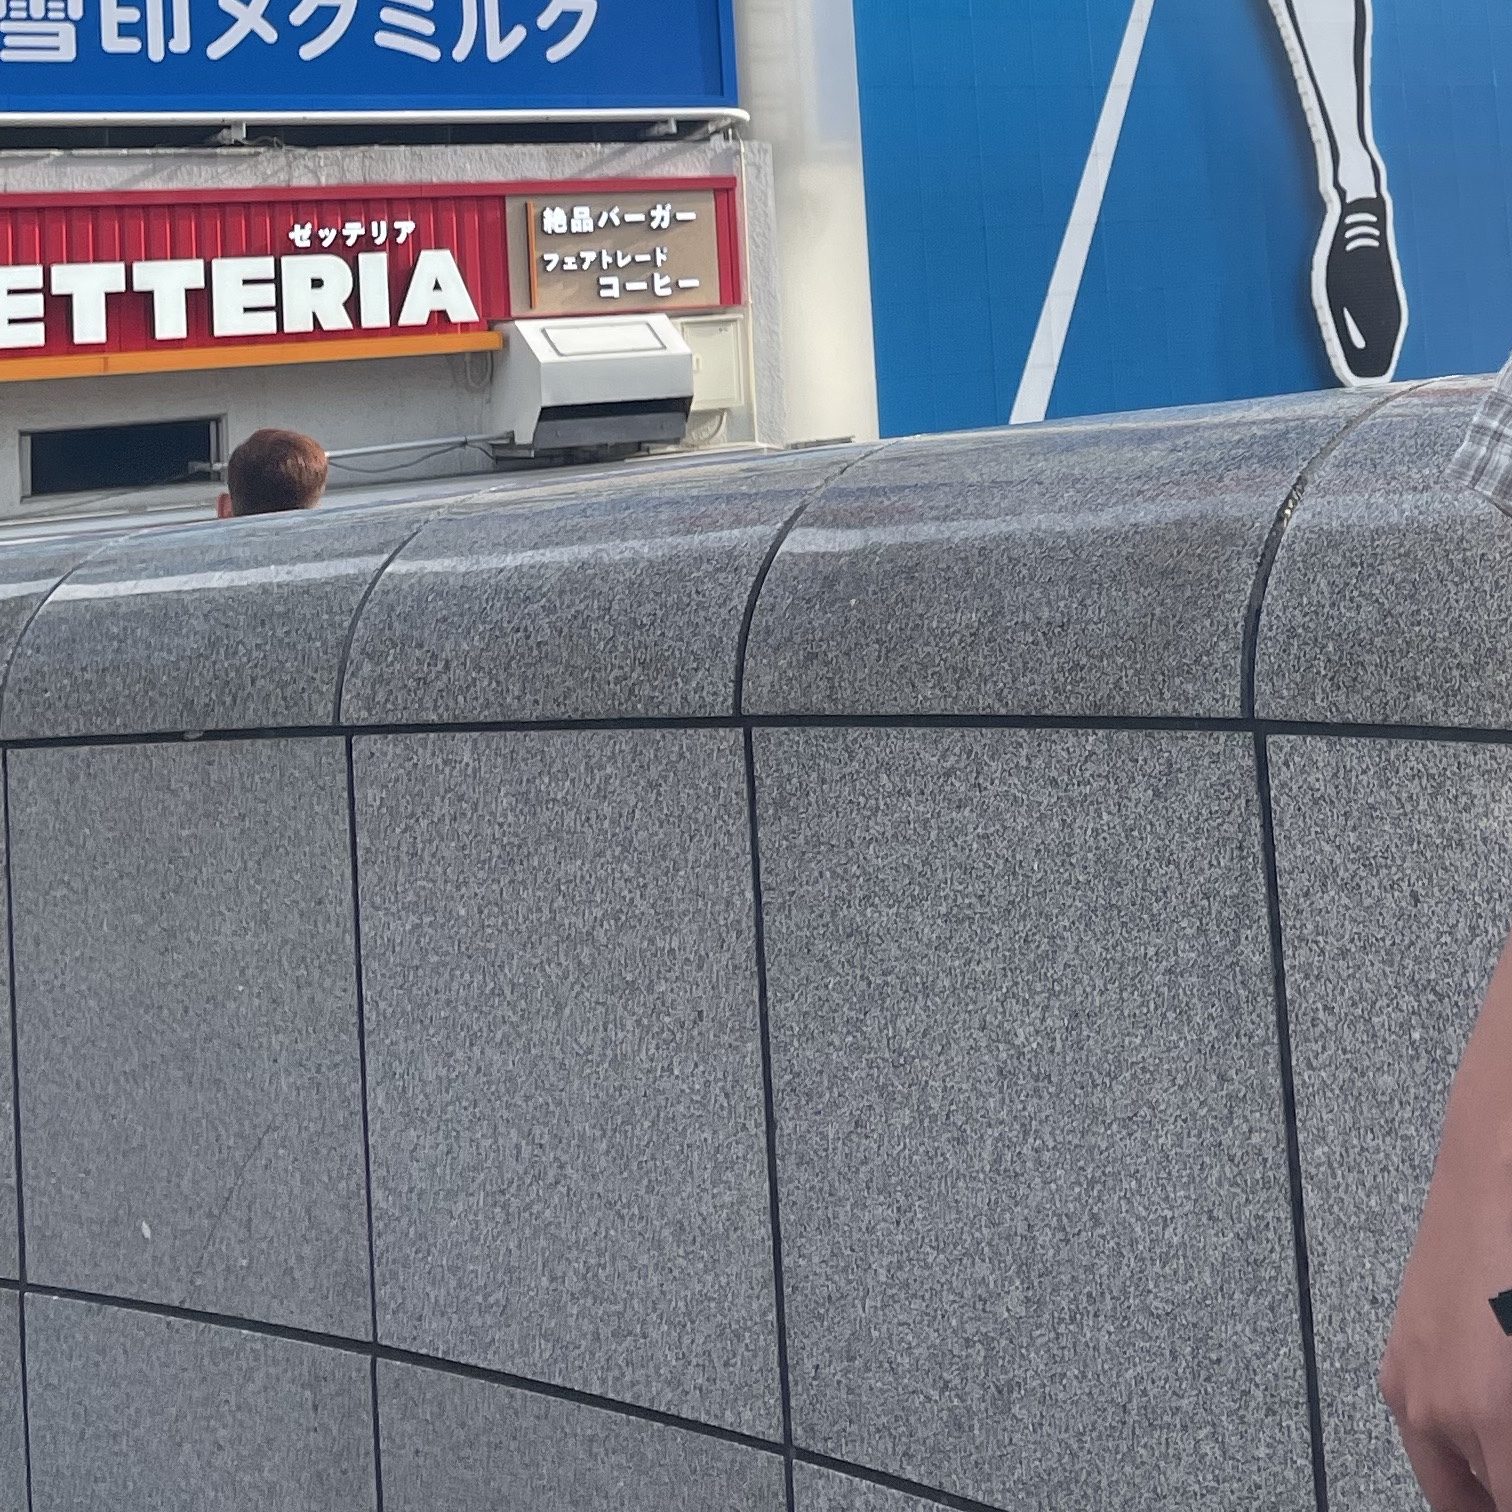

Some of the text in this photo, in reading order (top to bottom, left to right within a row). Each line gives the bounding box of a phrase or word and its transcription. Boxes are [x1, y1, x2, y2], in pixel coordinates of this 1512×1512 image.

[542, 202, 697, 235] 絶品バーガー
[288, 221, 416, 248] ゼッテリア
[543, 246, 669, 272] フェアトレード
[598, 272, 700, 299] コーヒー
